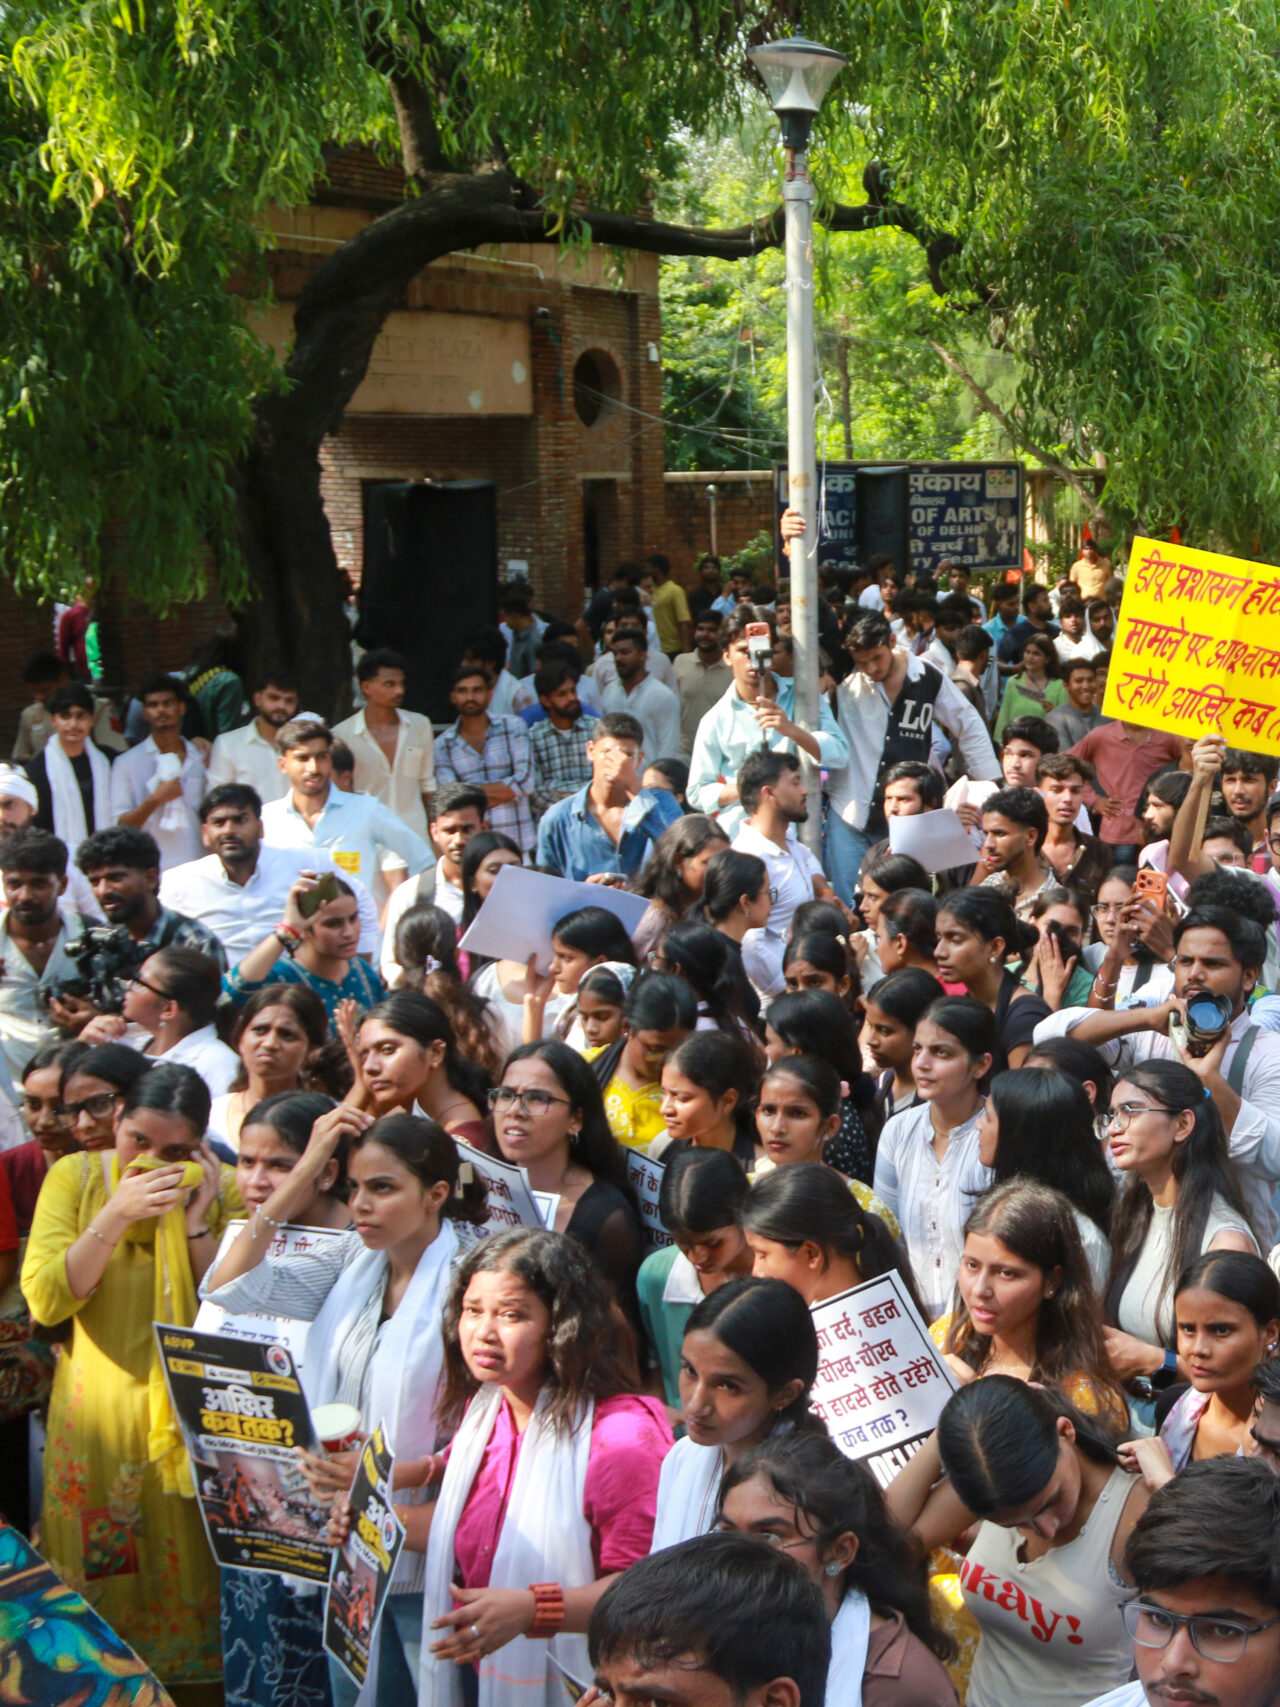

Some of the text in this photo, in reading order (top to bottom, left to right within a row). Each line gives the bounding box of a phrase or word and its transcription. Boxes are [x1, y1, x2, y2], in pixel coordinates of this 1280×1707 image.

[911, 507, 997, 524] OF ARTS
[917, 525, 936, 537] OF
[1134, 548, 1177, 603] डीयू
[1168, 562, 1252, 611] प्रशासन
[1124, 615, 1189, 663] मामले
[1185, 632, 1214, 667] पर
[1116, 667, 1170, 711] रहोगे
[1162, 683, 1236, 732] आखिर
[1232, 698, 1276, 738] कब
[647, 1170, 660, 1193] के
[829, 1311, 863, 1341] दर्द,
[858, 1298, 901, 1329] बहन
[201, 1383, 277, 1420] आखिर
[826, 1383, 873, 1418] हादसे
[870, 1370, 904, 1402] होते
[898, 1355, 941, 1389] रहेंगे
[838, 1425, 870, 1449] कब
[865, 1412, 898, 1440] तक
